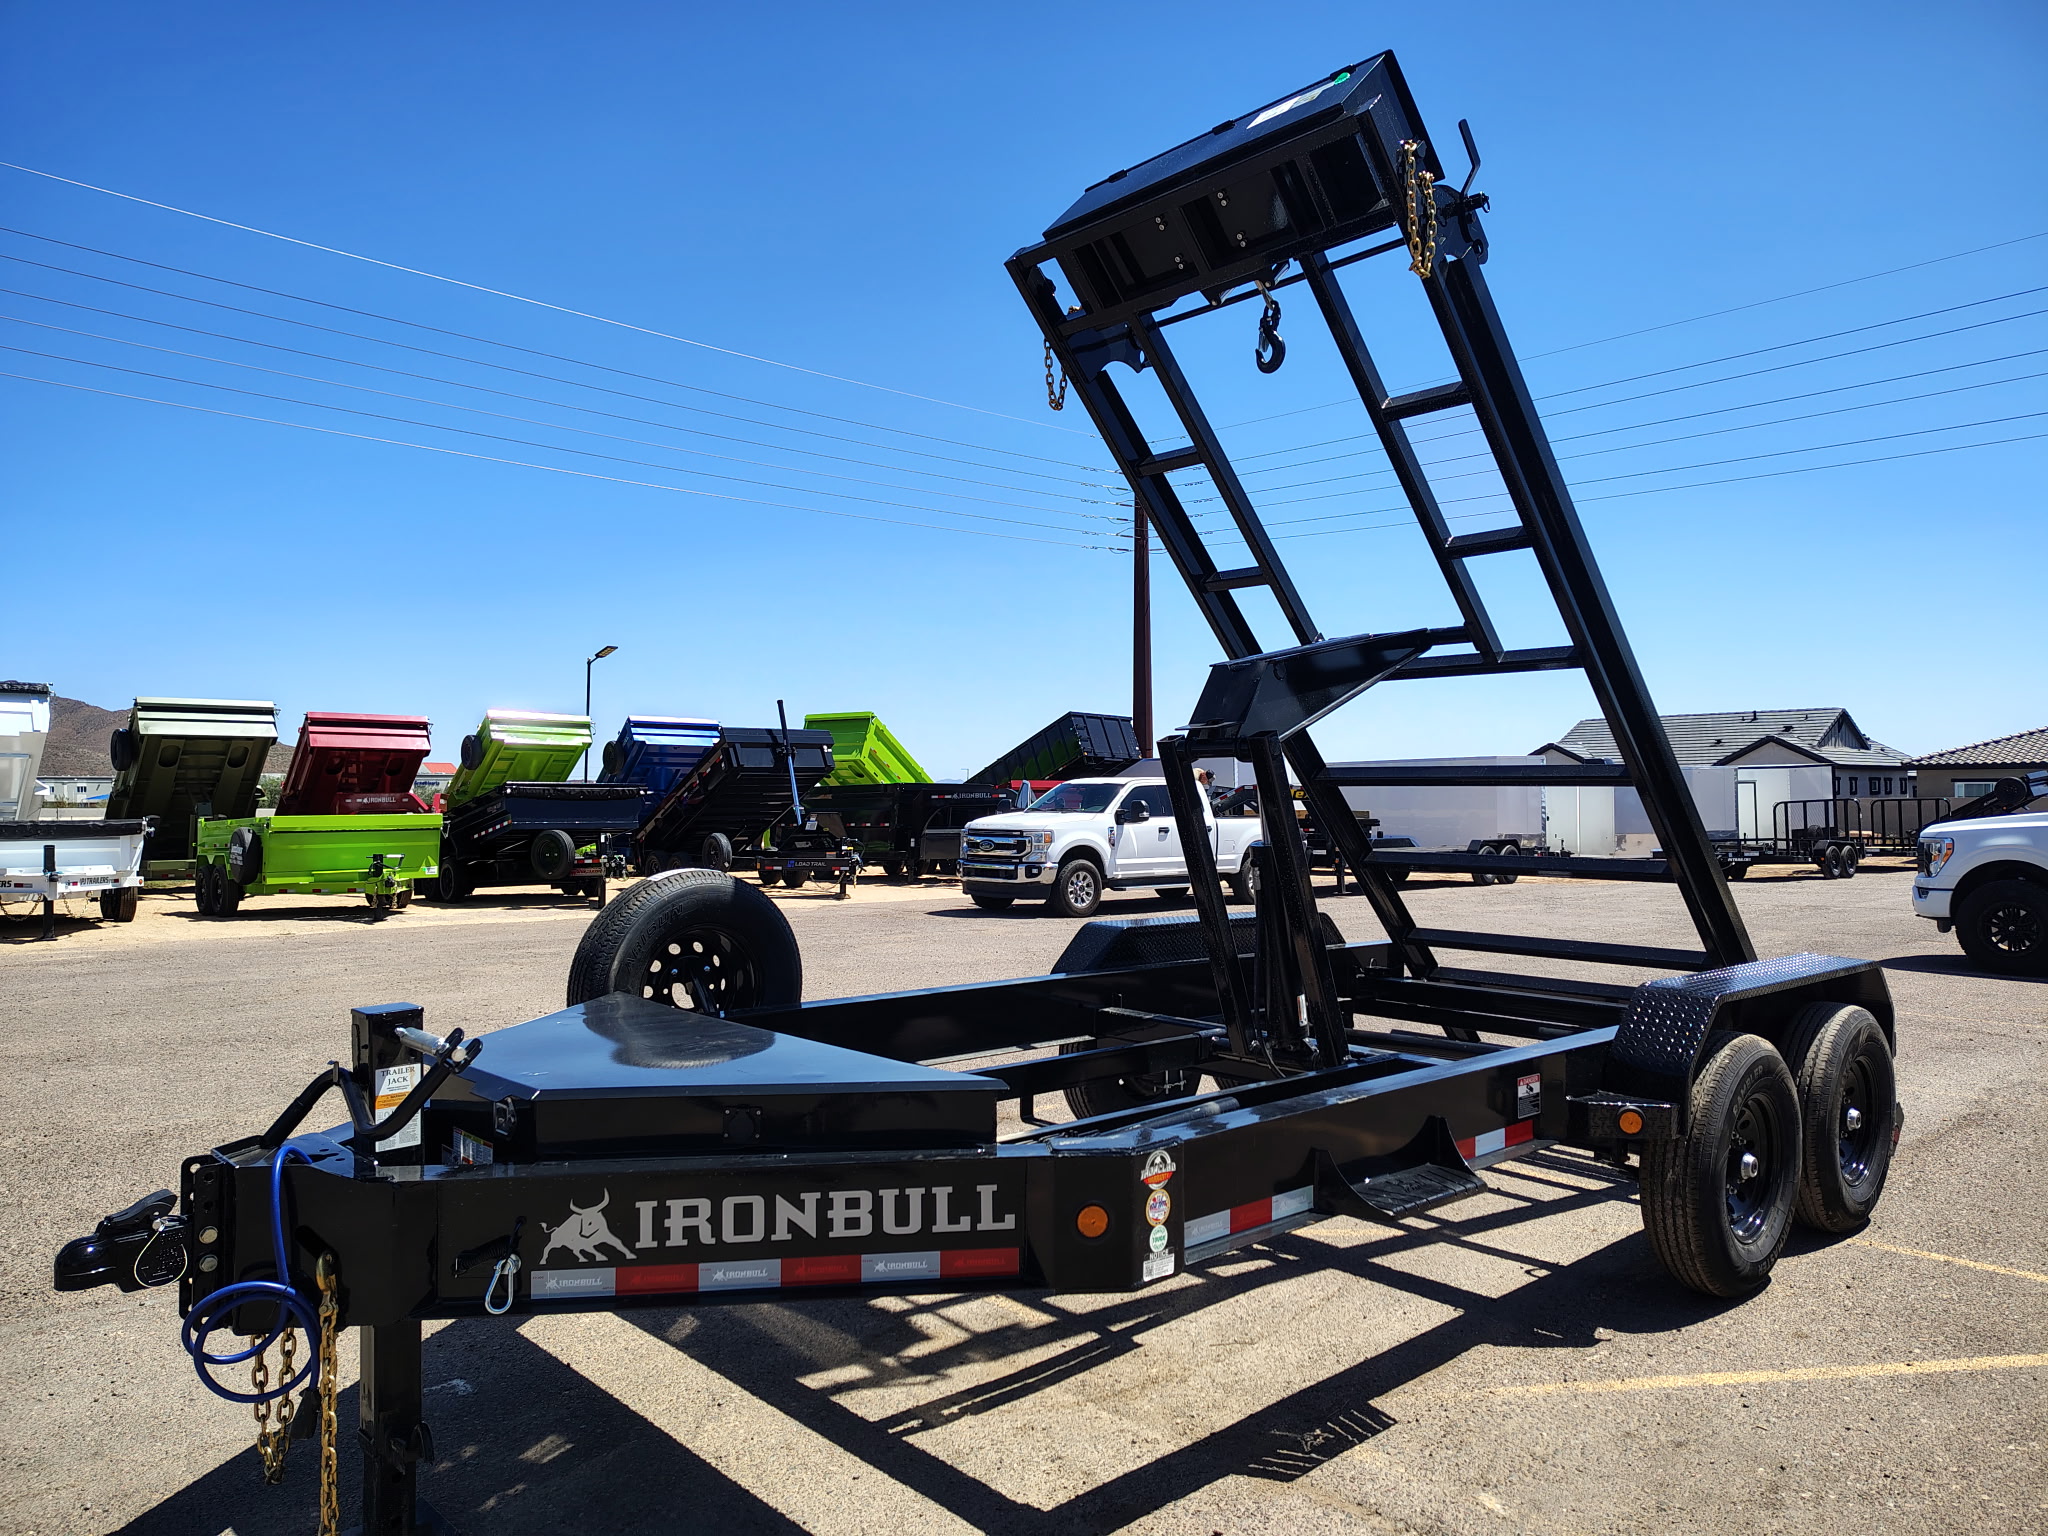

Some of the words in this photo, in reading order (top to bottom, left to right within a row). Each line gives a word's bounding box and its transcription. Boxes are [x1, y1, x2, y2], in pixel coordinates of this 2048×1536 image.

[381, 1066, 416, 1077] TRAILER
[387, 1076, 409, 1086] JACK
[634, 1184, 1016, 1249] IRONBULL
[1149, 1248, 1169, 1261] NOTICE
[887, 1259, 928, 1270] IRONBULL
[726, 1268, 768, 1279] IRONBULL
[559, 1275, 603, 1287] IRONBULL
